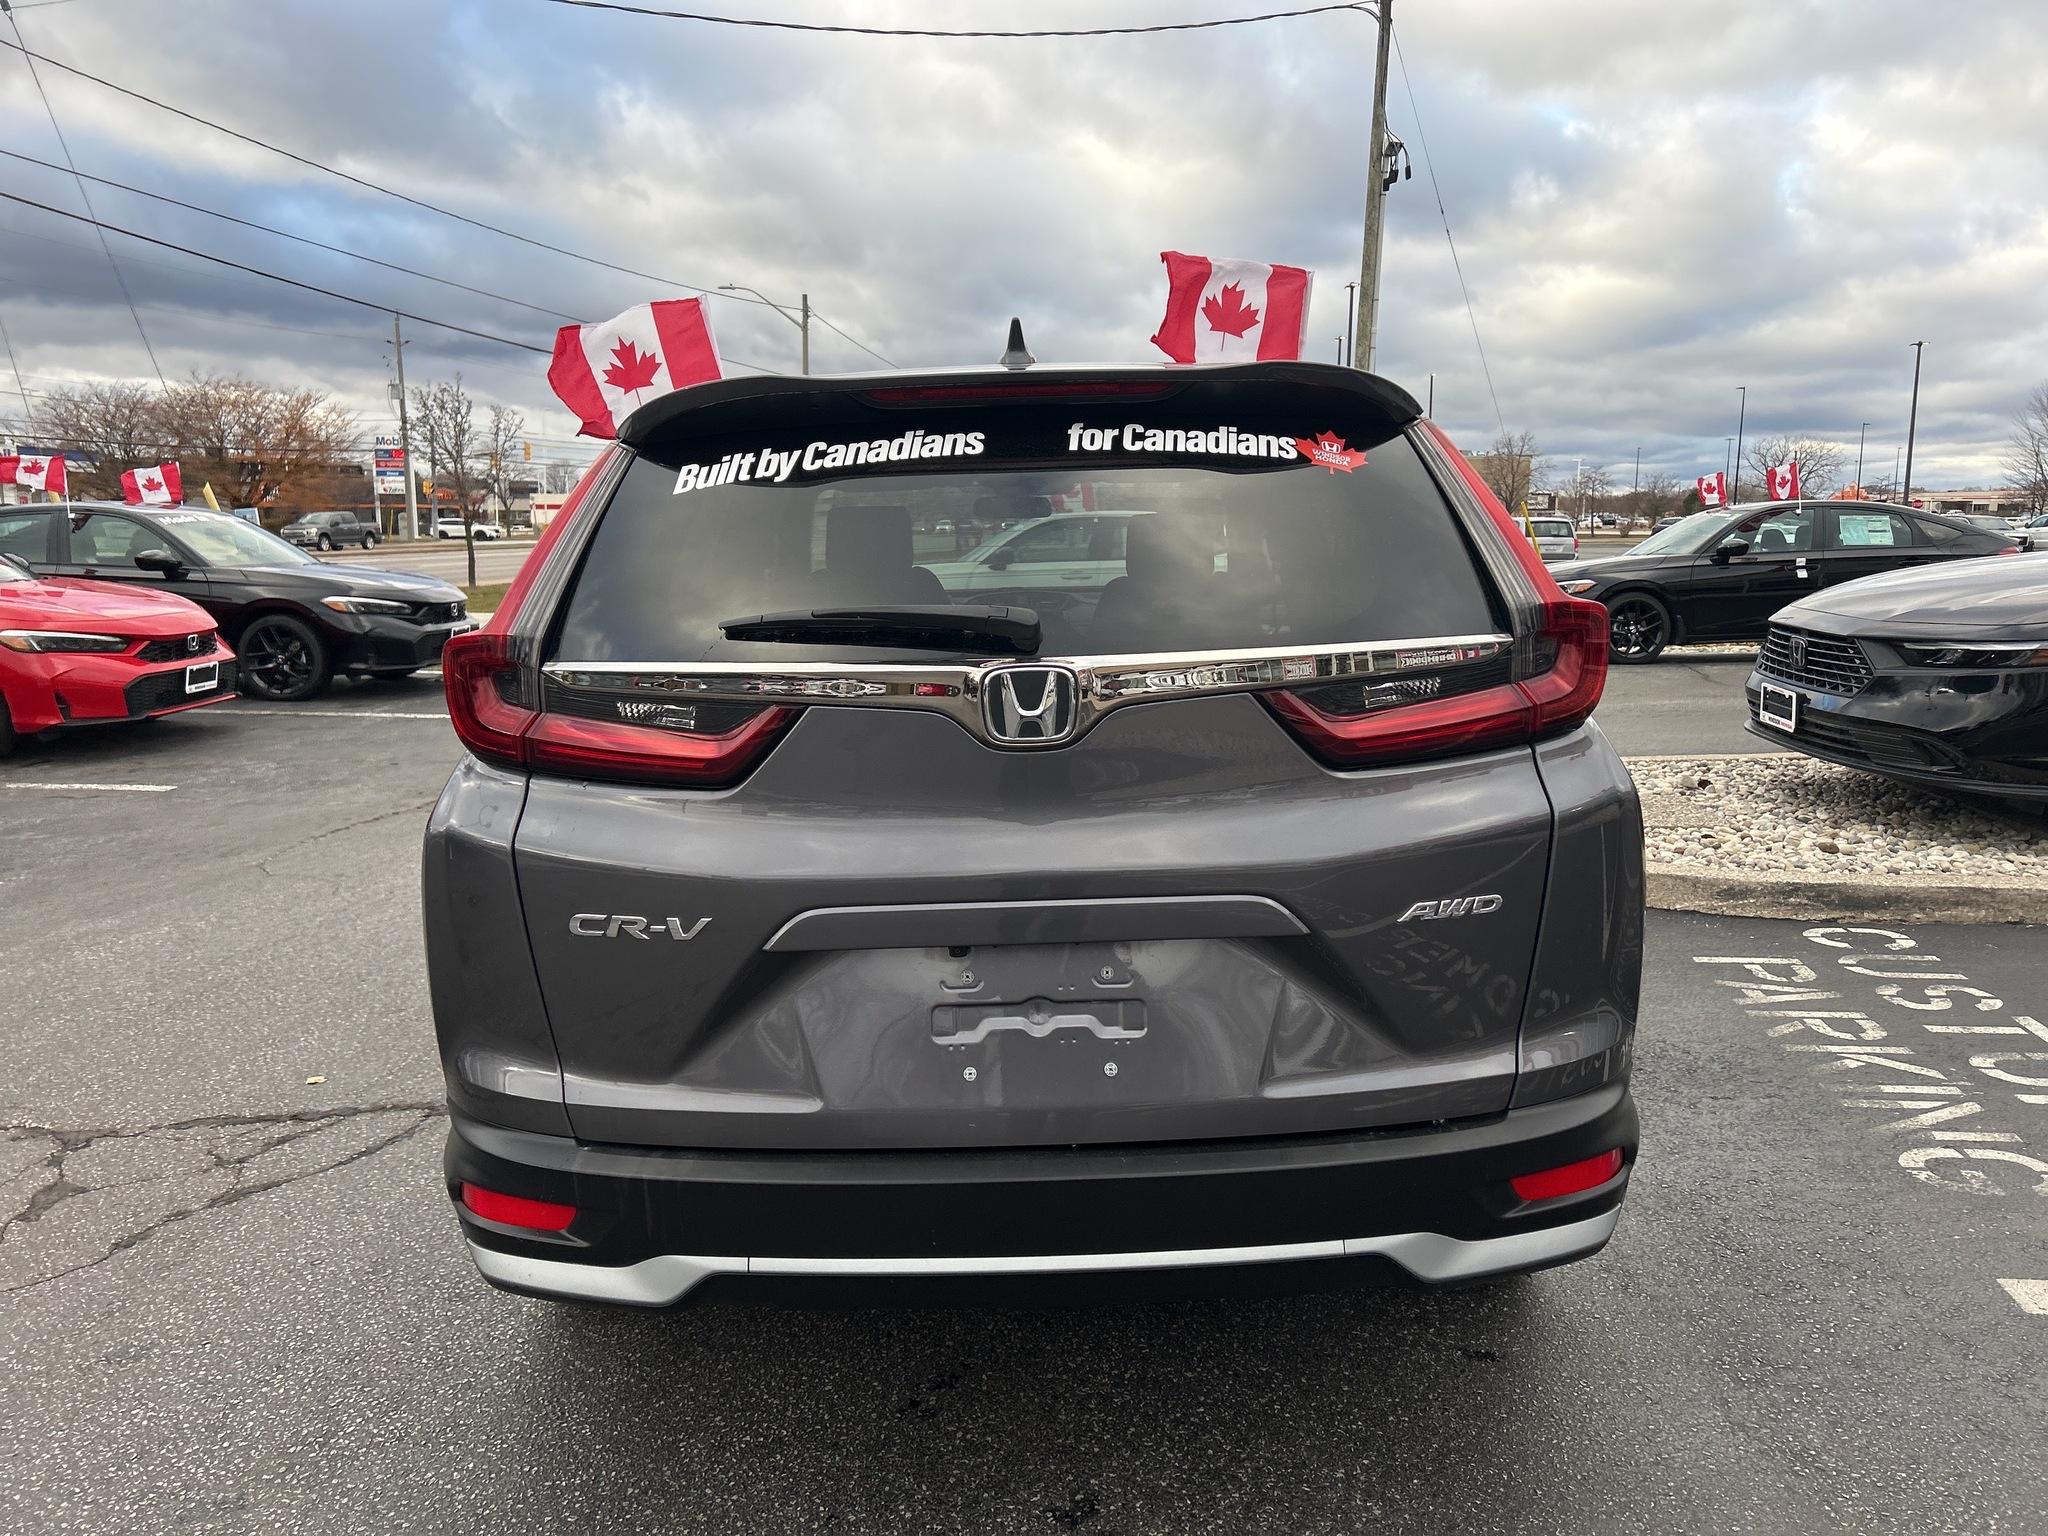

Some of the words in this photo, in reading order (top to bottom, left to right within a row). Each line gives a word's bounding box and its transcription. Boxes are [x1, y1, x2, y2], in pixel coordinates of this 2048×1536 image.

[376, 436, 402, 446] Mobi
[672, 452, 756, 495] Built
[755, 447, 802, 483] by
[802, 429, 985, 471] Canadians
[1068, 423, 1119, 451] for
[1122, 423, 1298, 460] Canadians
[1312, 449, 1351, 463] WINDSOR
[1315, 454, 1349, 467] HONDA
[1397, 894, 1503, 922] AWD
[569, 913, 712, 941] CR-V
